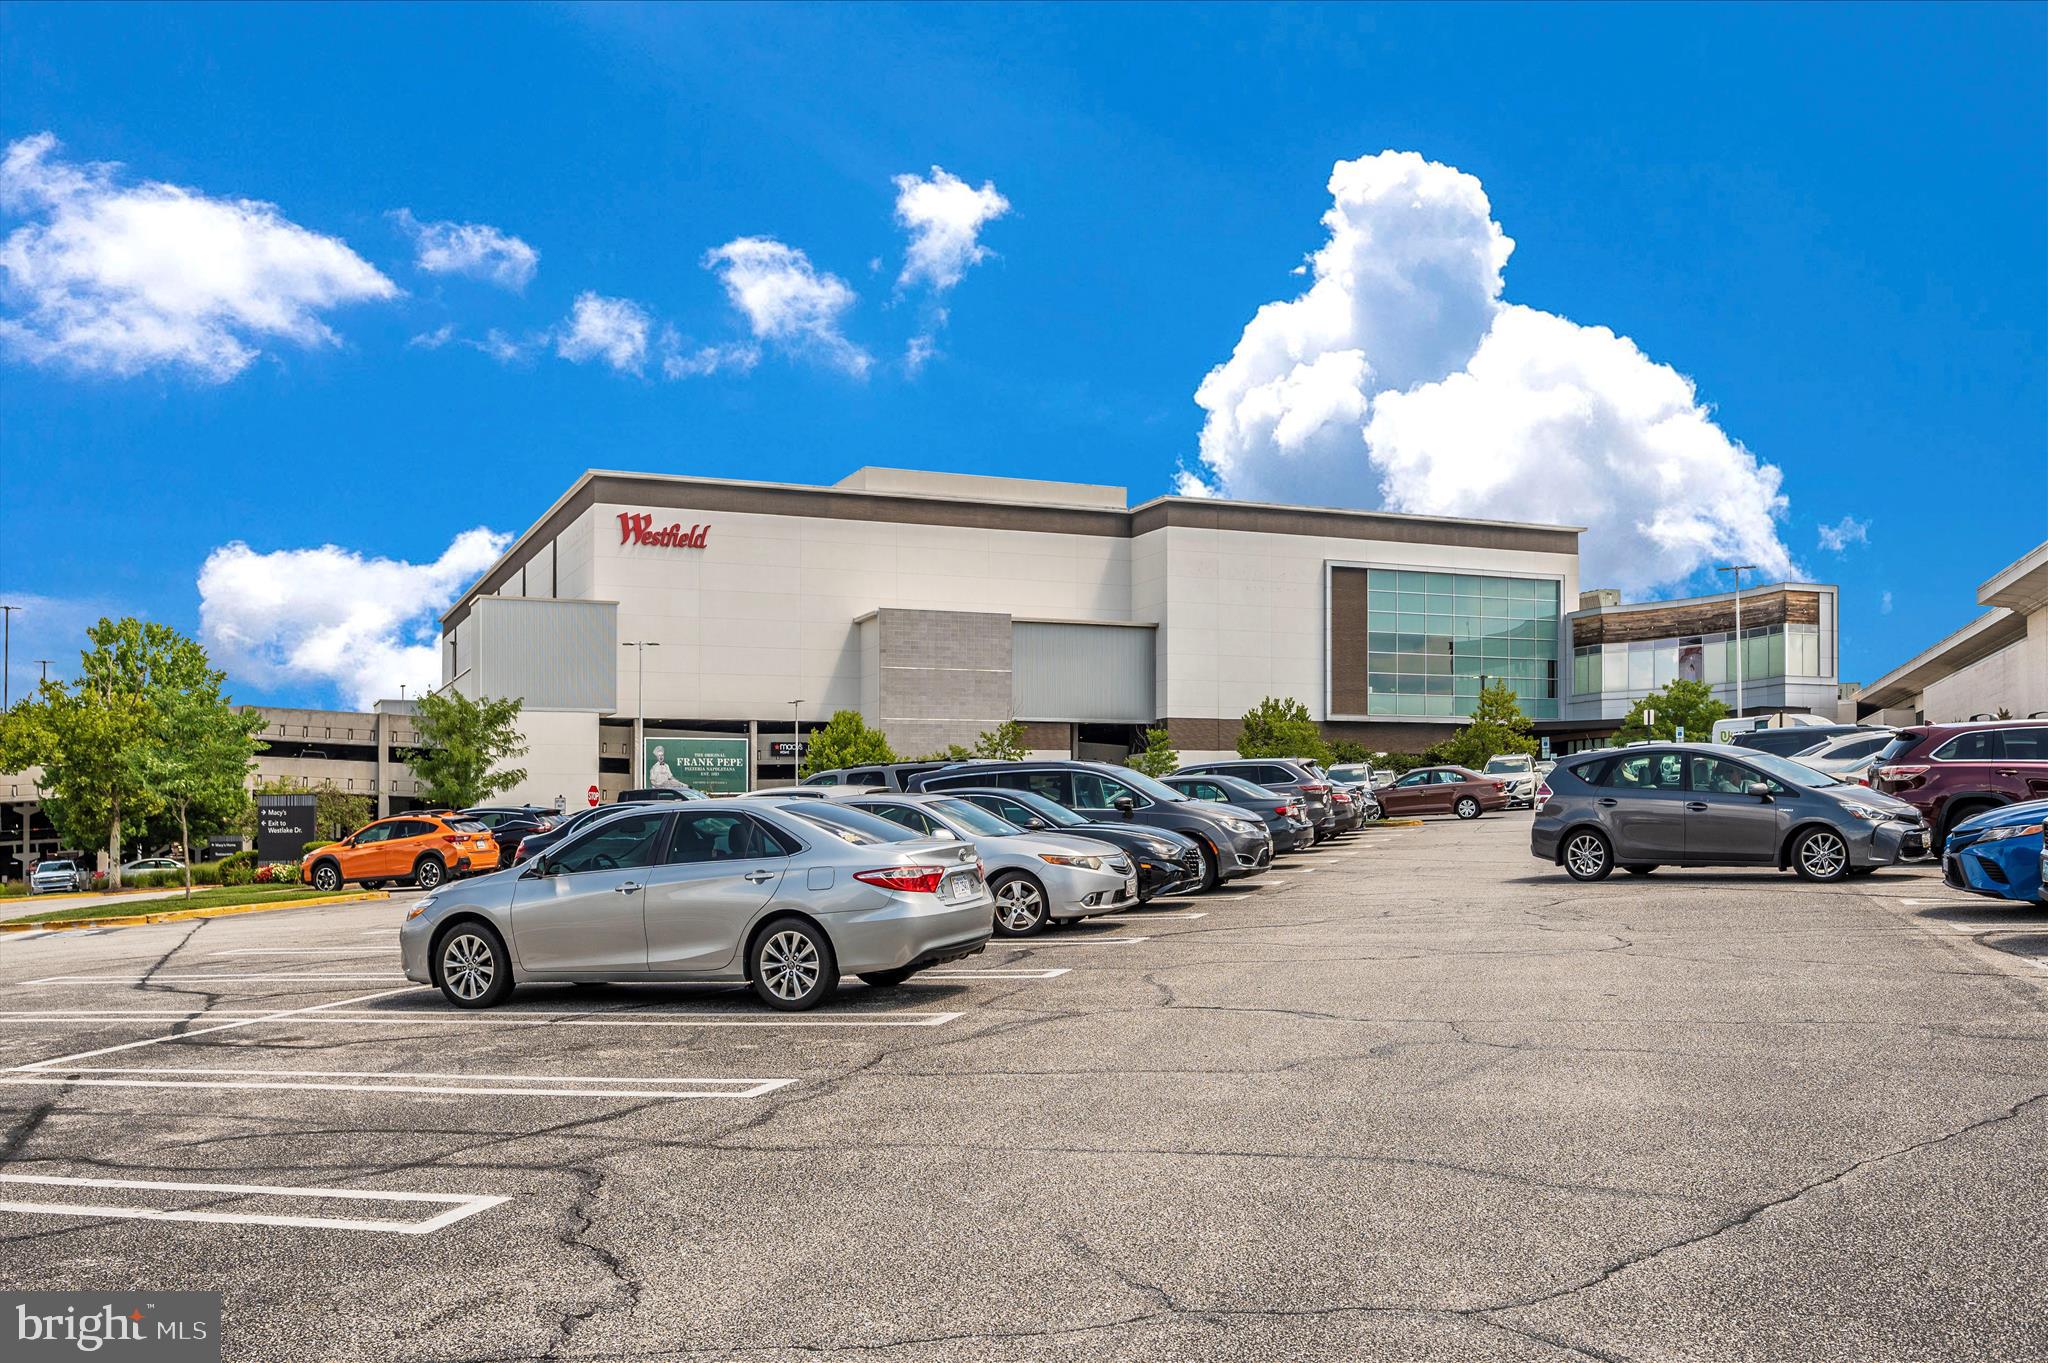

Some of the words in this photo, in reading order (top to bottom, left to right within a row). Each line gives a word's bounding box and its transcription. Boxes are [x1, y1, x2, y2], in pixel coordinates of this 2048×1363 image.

[616, 512, 711, 549] Westfield
[677, 757, 714, 766] FRANK
[717, 758, 744, 767] PEPE
[588, 792, 599, 800] STOP
